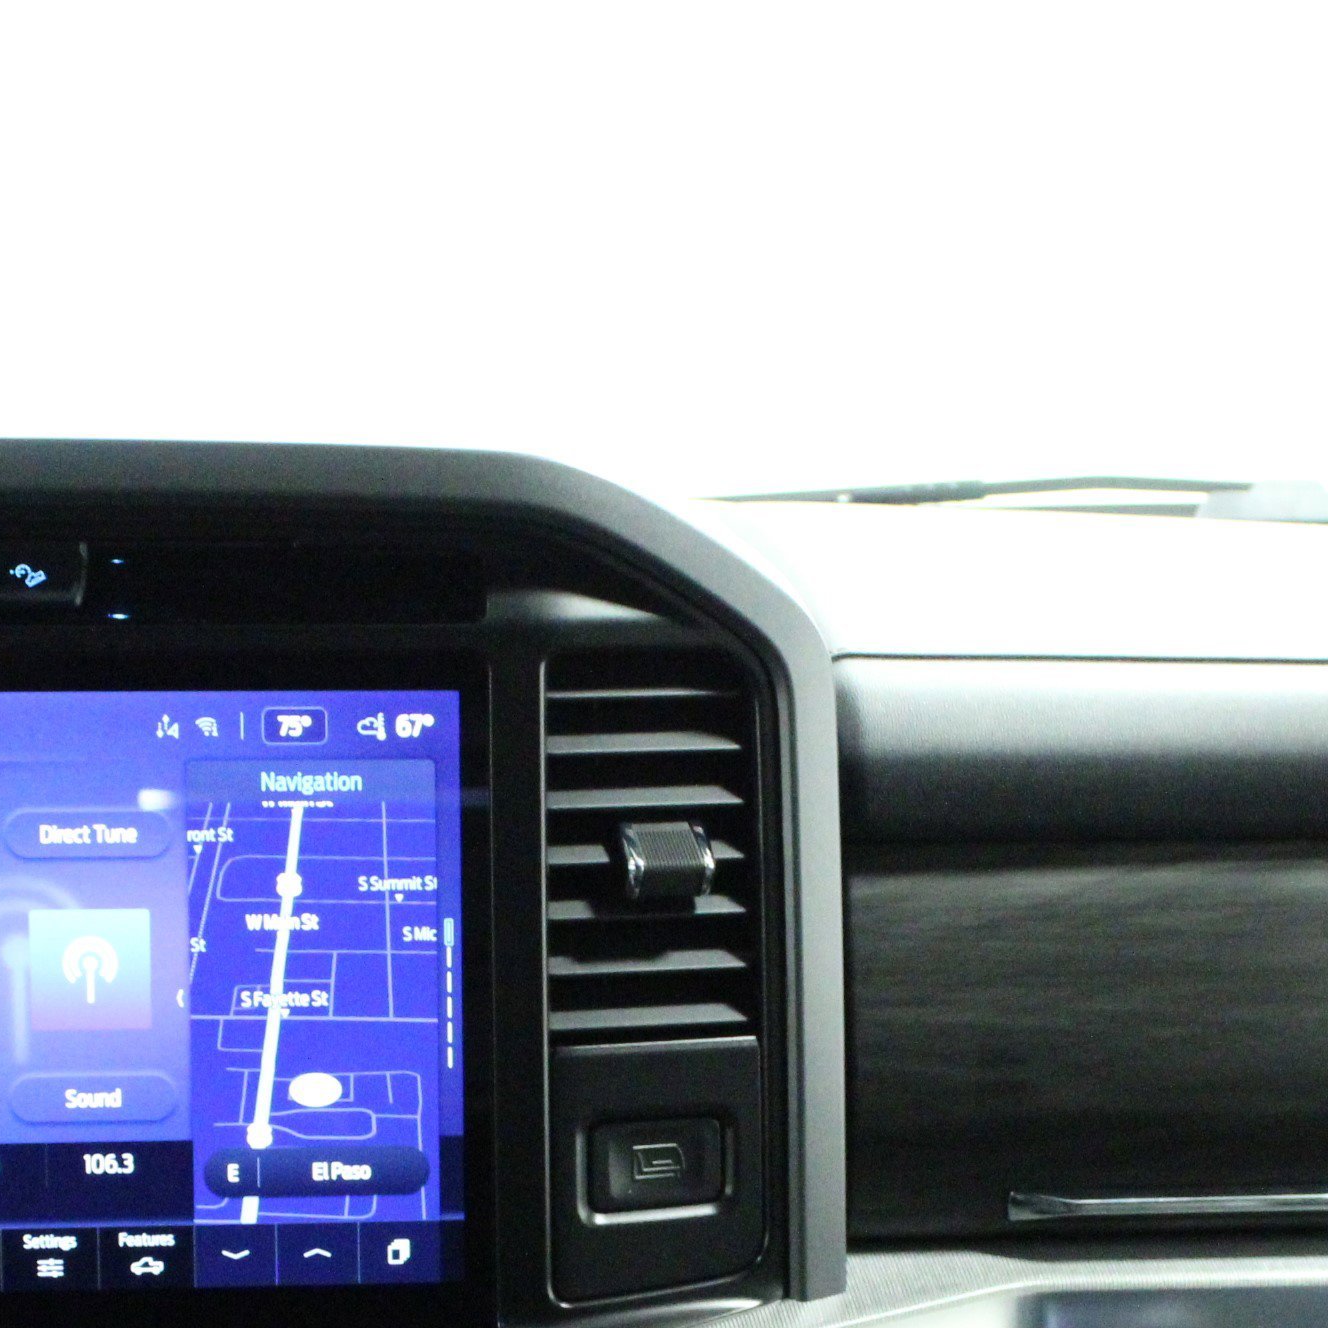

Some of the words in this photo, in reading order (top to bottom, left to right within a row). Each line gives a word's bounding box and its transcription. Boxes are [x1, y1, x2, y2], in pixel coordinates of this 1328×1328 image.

[260, 771, 363, 795] Navigation
[39, 824, 90, 844] Direct
[93, 824, 138, 844] Tune
[369, 875, 423, 891] Summit
[245, 913, 262, 931] W
[263, 913, 301, 930] Mn
[301, 912, 320, 931] St
[240, 990, 252, 1008] S
[310, 989, 329, 1007] St
[65, 1089, 122, 1109] Sound
[83, 1153, 134, 1175] 106.3
[227, 1164, 240, 1183] E
[331, 1162, 372, 1181] Paso
[23, 1234, 77, 1252] Settings
[117, 1232, 175, 1249] Features
